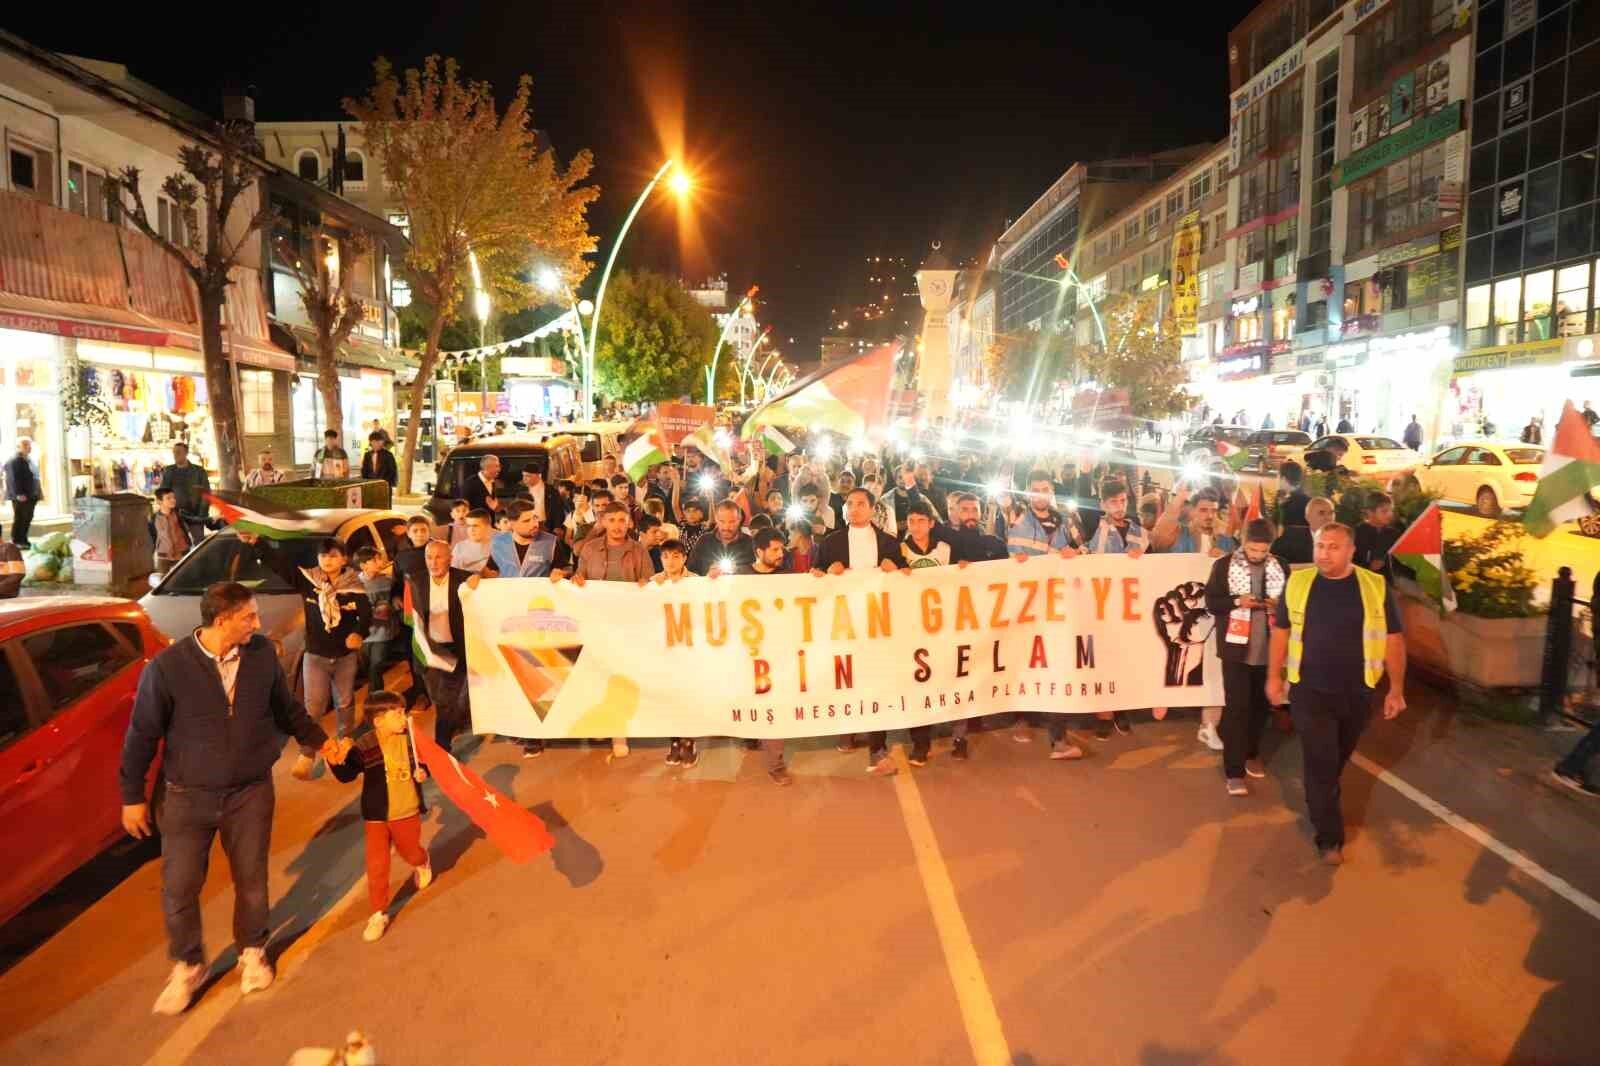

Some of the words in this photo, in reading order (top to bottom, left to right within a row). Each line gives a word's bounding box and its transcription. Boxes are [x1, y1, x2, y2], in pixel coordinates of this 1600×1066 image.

[664, 592, 892, 656] MUŞ'TAN
[920, 577, 1142, 634] GAZZE'YE
[754, 649, 853, 694] BİN
[913, 634, 1096, 683] SELAM
[732, 708, 774, 725] MUŞ
[925, 690, 975, 709] AKSA
[991, 680, 1117, 698] PLATFORMU
